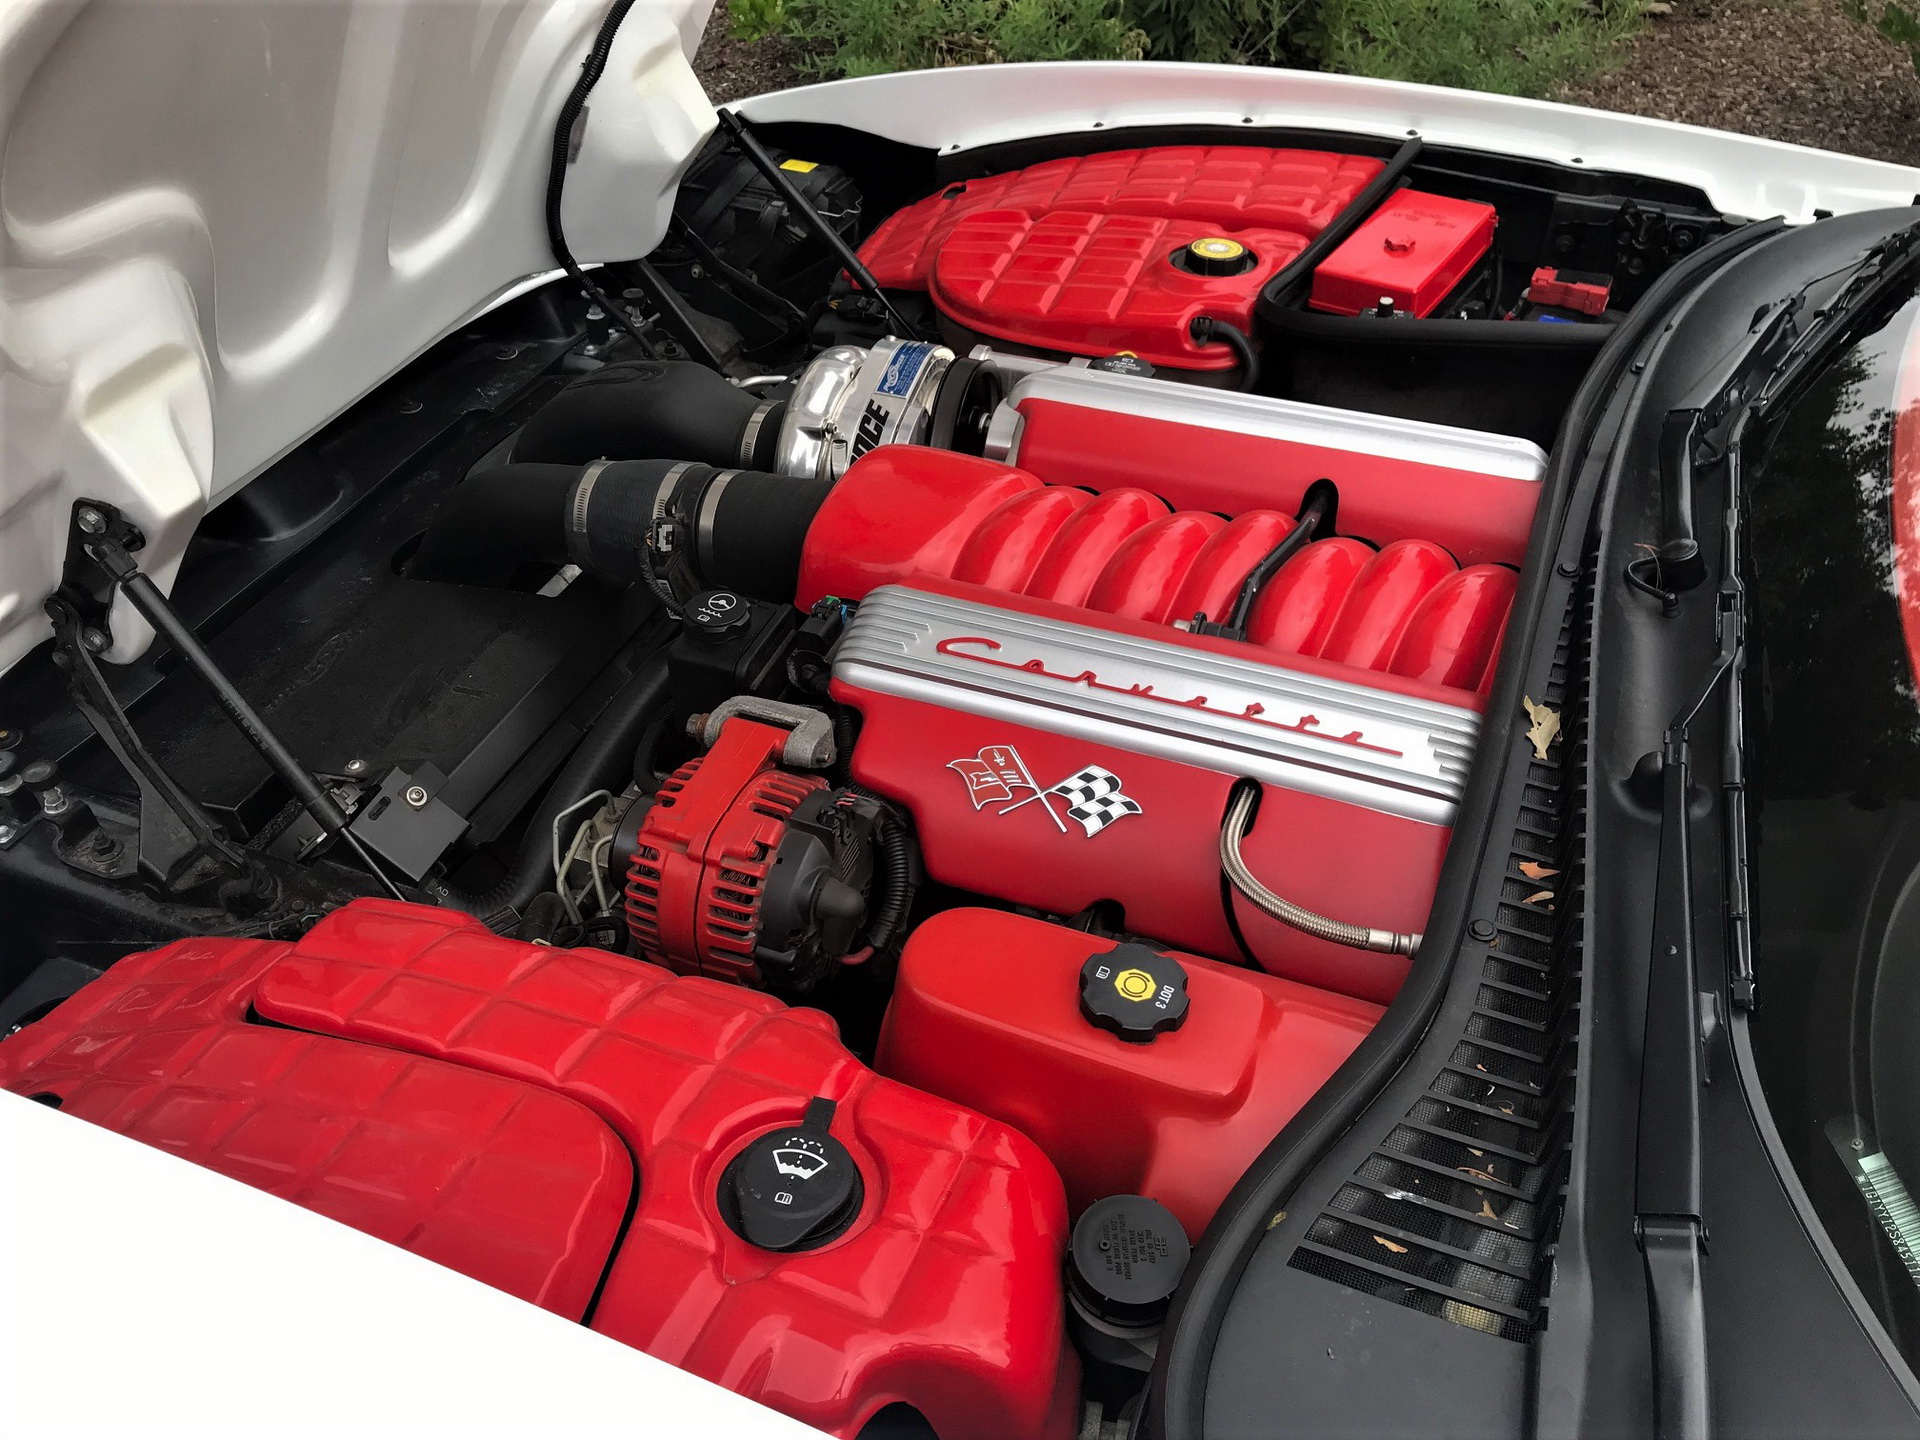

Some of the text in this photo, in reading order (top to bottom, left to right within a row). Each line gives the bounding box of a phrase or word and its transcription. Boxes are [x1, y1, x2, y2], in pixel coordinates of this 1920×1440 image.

[935, 637, 1404, 757] Corvette
[1155, 984, 1175, 1010] DOT 3
